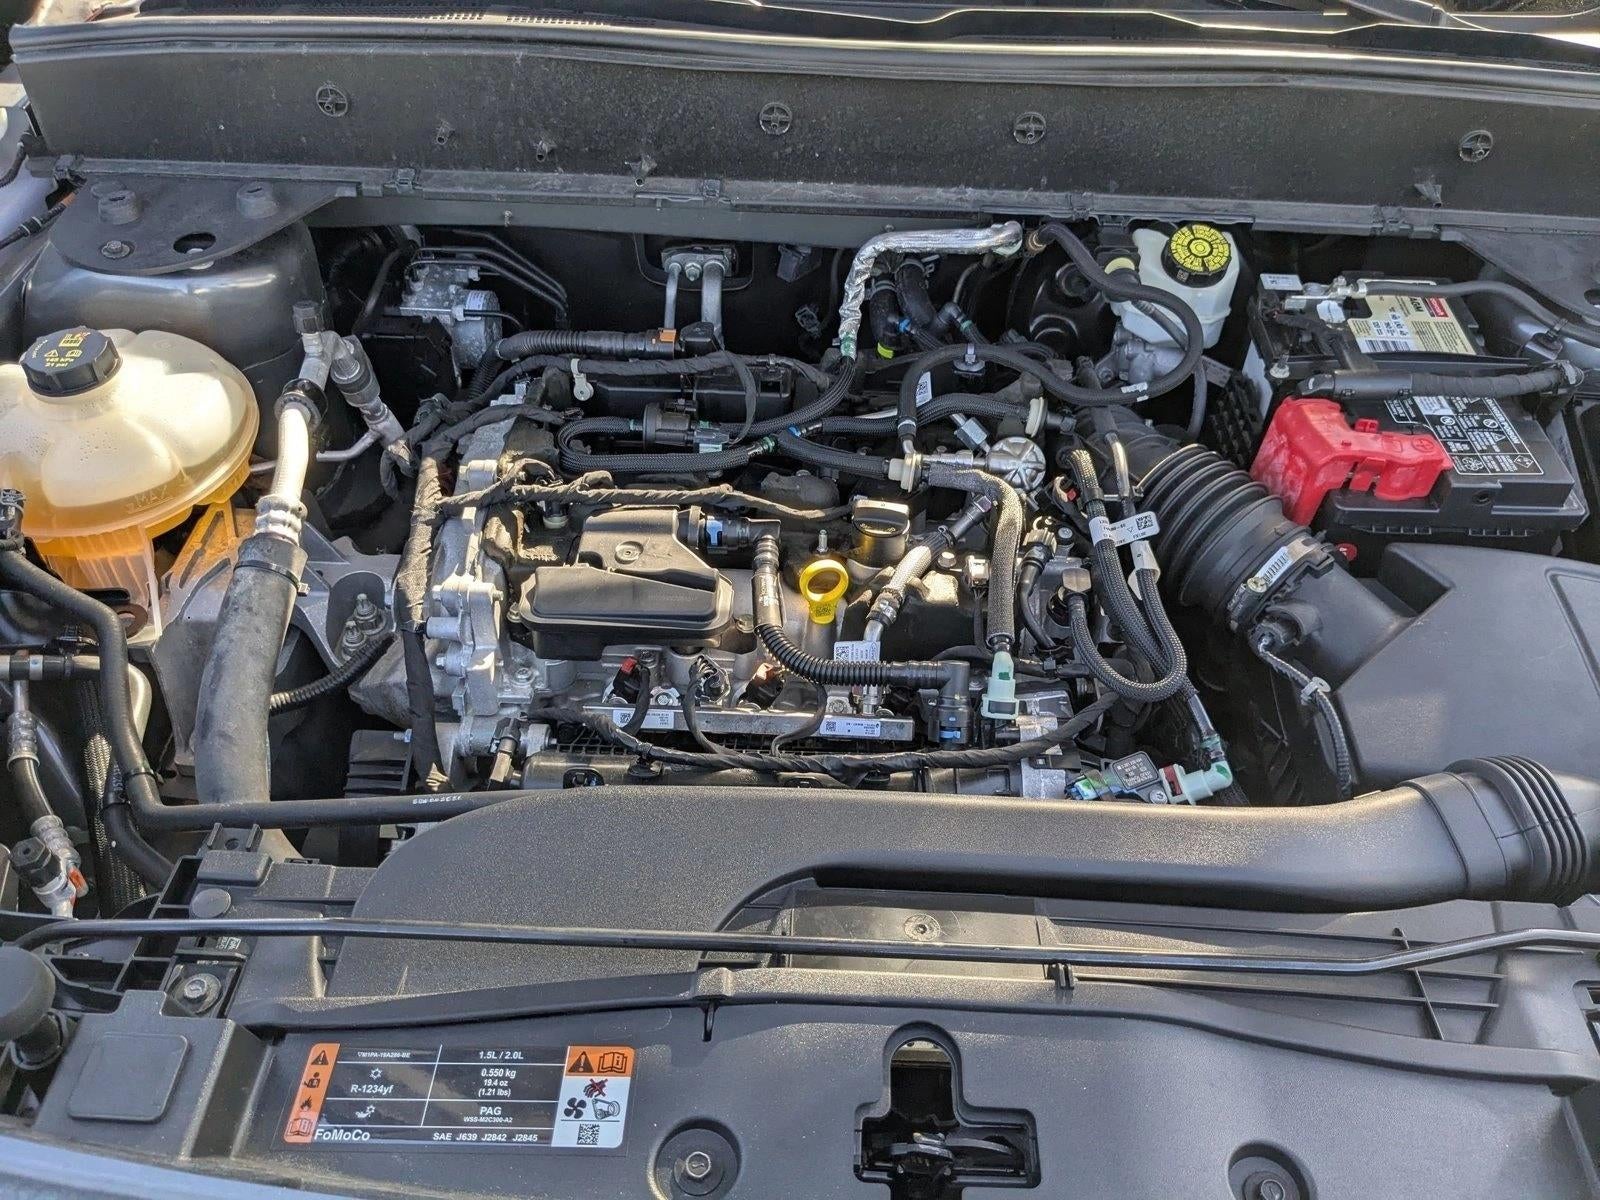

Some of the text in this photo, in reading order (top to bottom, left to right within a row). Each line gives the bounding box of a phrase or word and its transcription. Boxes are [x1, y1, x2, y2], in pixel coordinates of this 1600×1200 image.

[479, 1051, 498, 1060] 1.5L
[504, 1051, 524, 1060] 2.0L
[481, 1068, 517, 1079] 0.550 kg
[483, 1078, 499, 1087] 19.4
[350, 1084, 394, 1095] R-1234yf
[478, 1088, 511, 1098] (1.21 lbs)
[480, 1106, 502, 1116] PAG
[314, 1128, 371, 1141] FoMoCo
[432, 1132, 538, 1142] SAE J639 J2842 J2845
